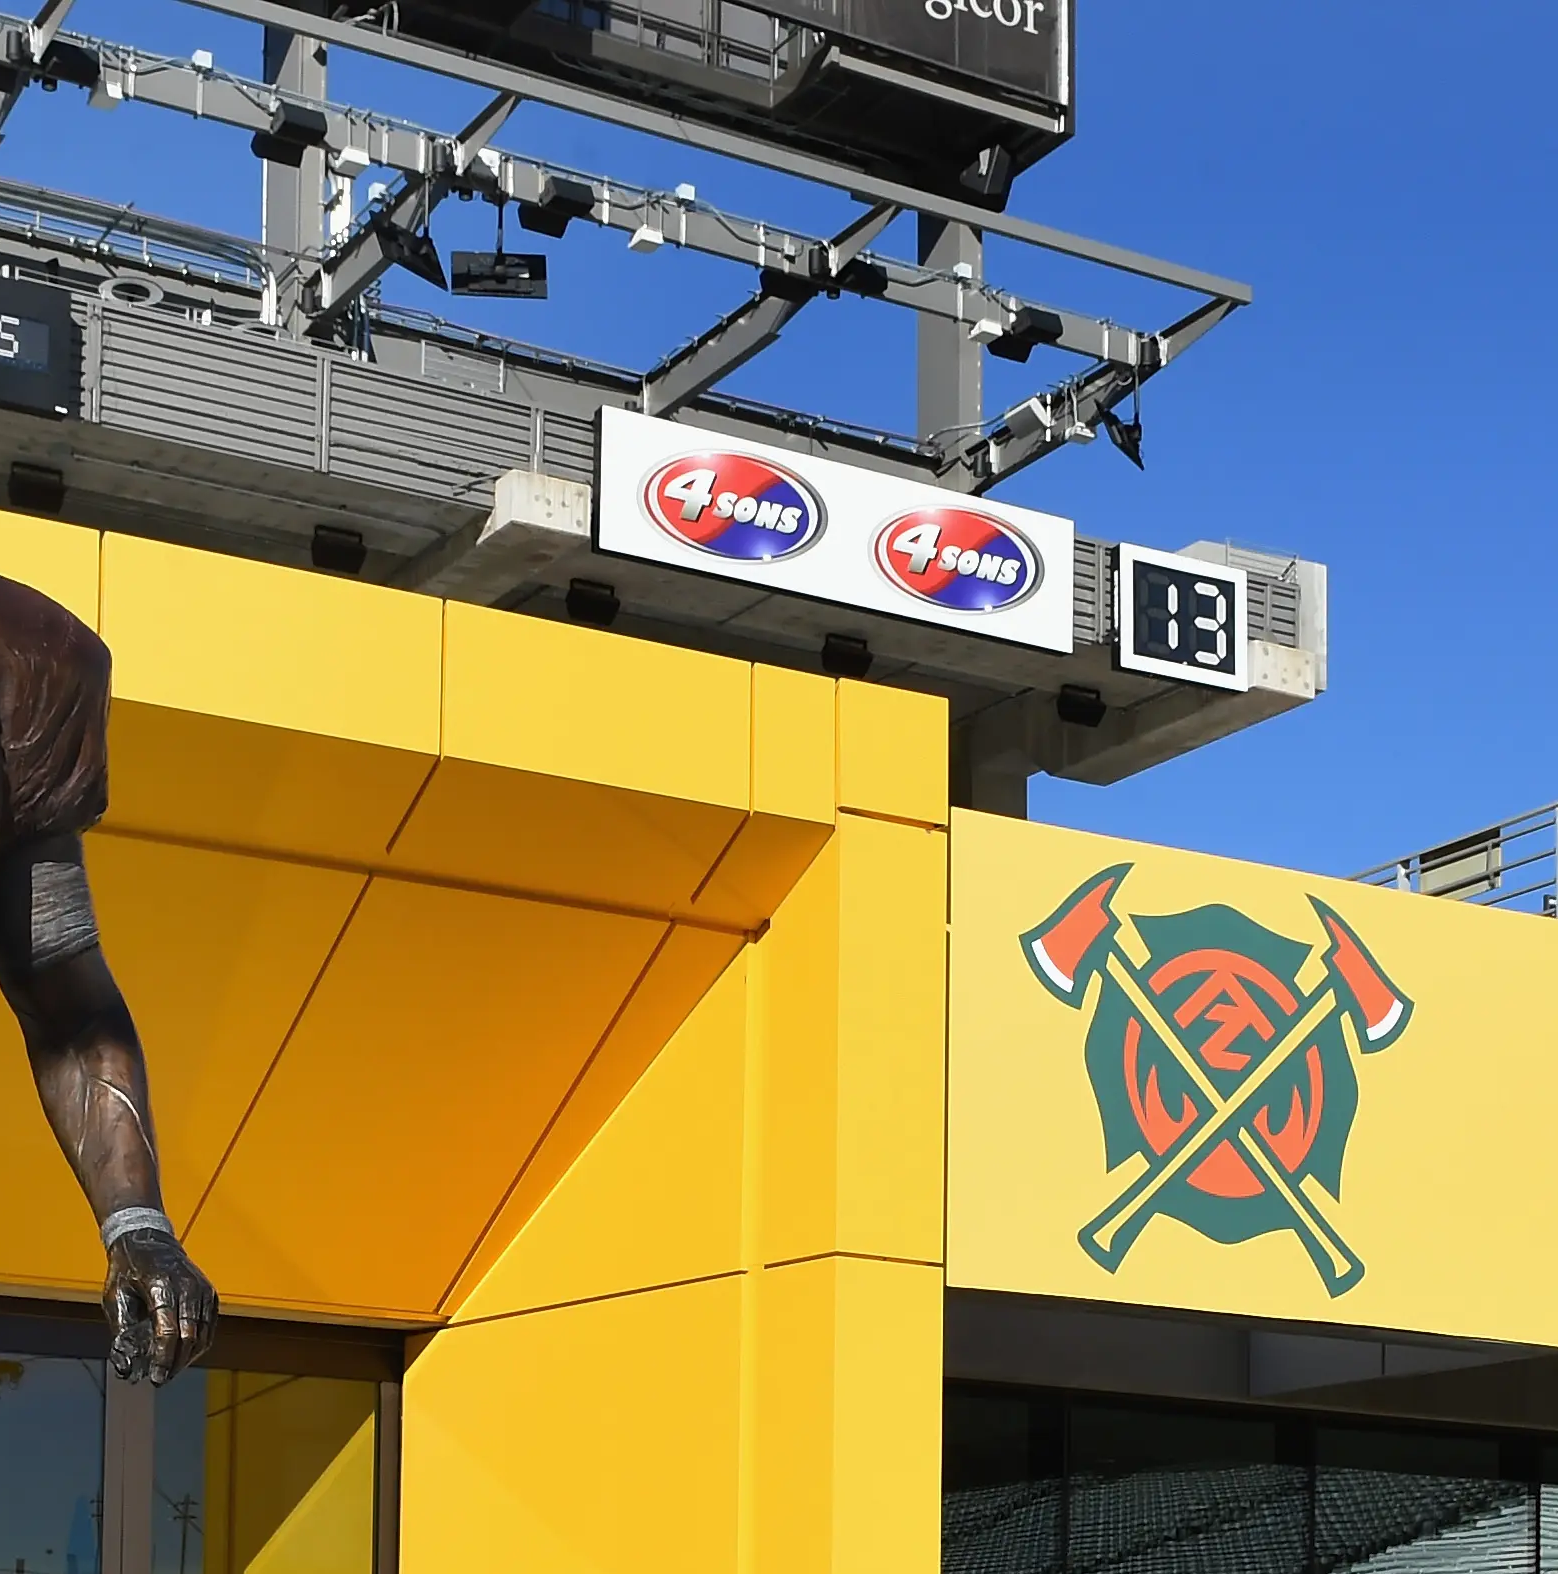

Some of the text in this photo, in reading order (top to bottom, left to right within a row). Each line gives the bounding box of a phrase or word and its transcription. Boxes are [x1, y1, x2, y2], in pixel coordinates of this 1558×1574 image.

[663, 467, 802, 536] 4 SONS
[891, 522, 1022, 587] 4 SONS
[1166, 581, 1228, 666] 13
